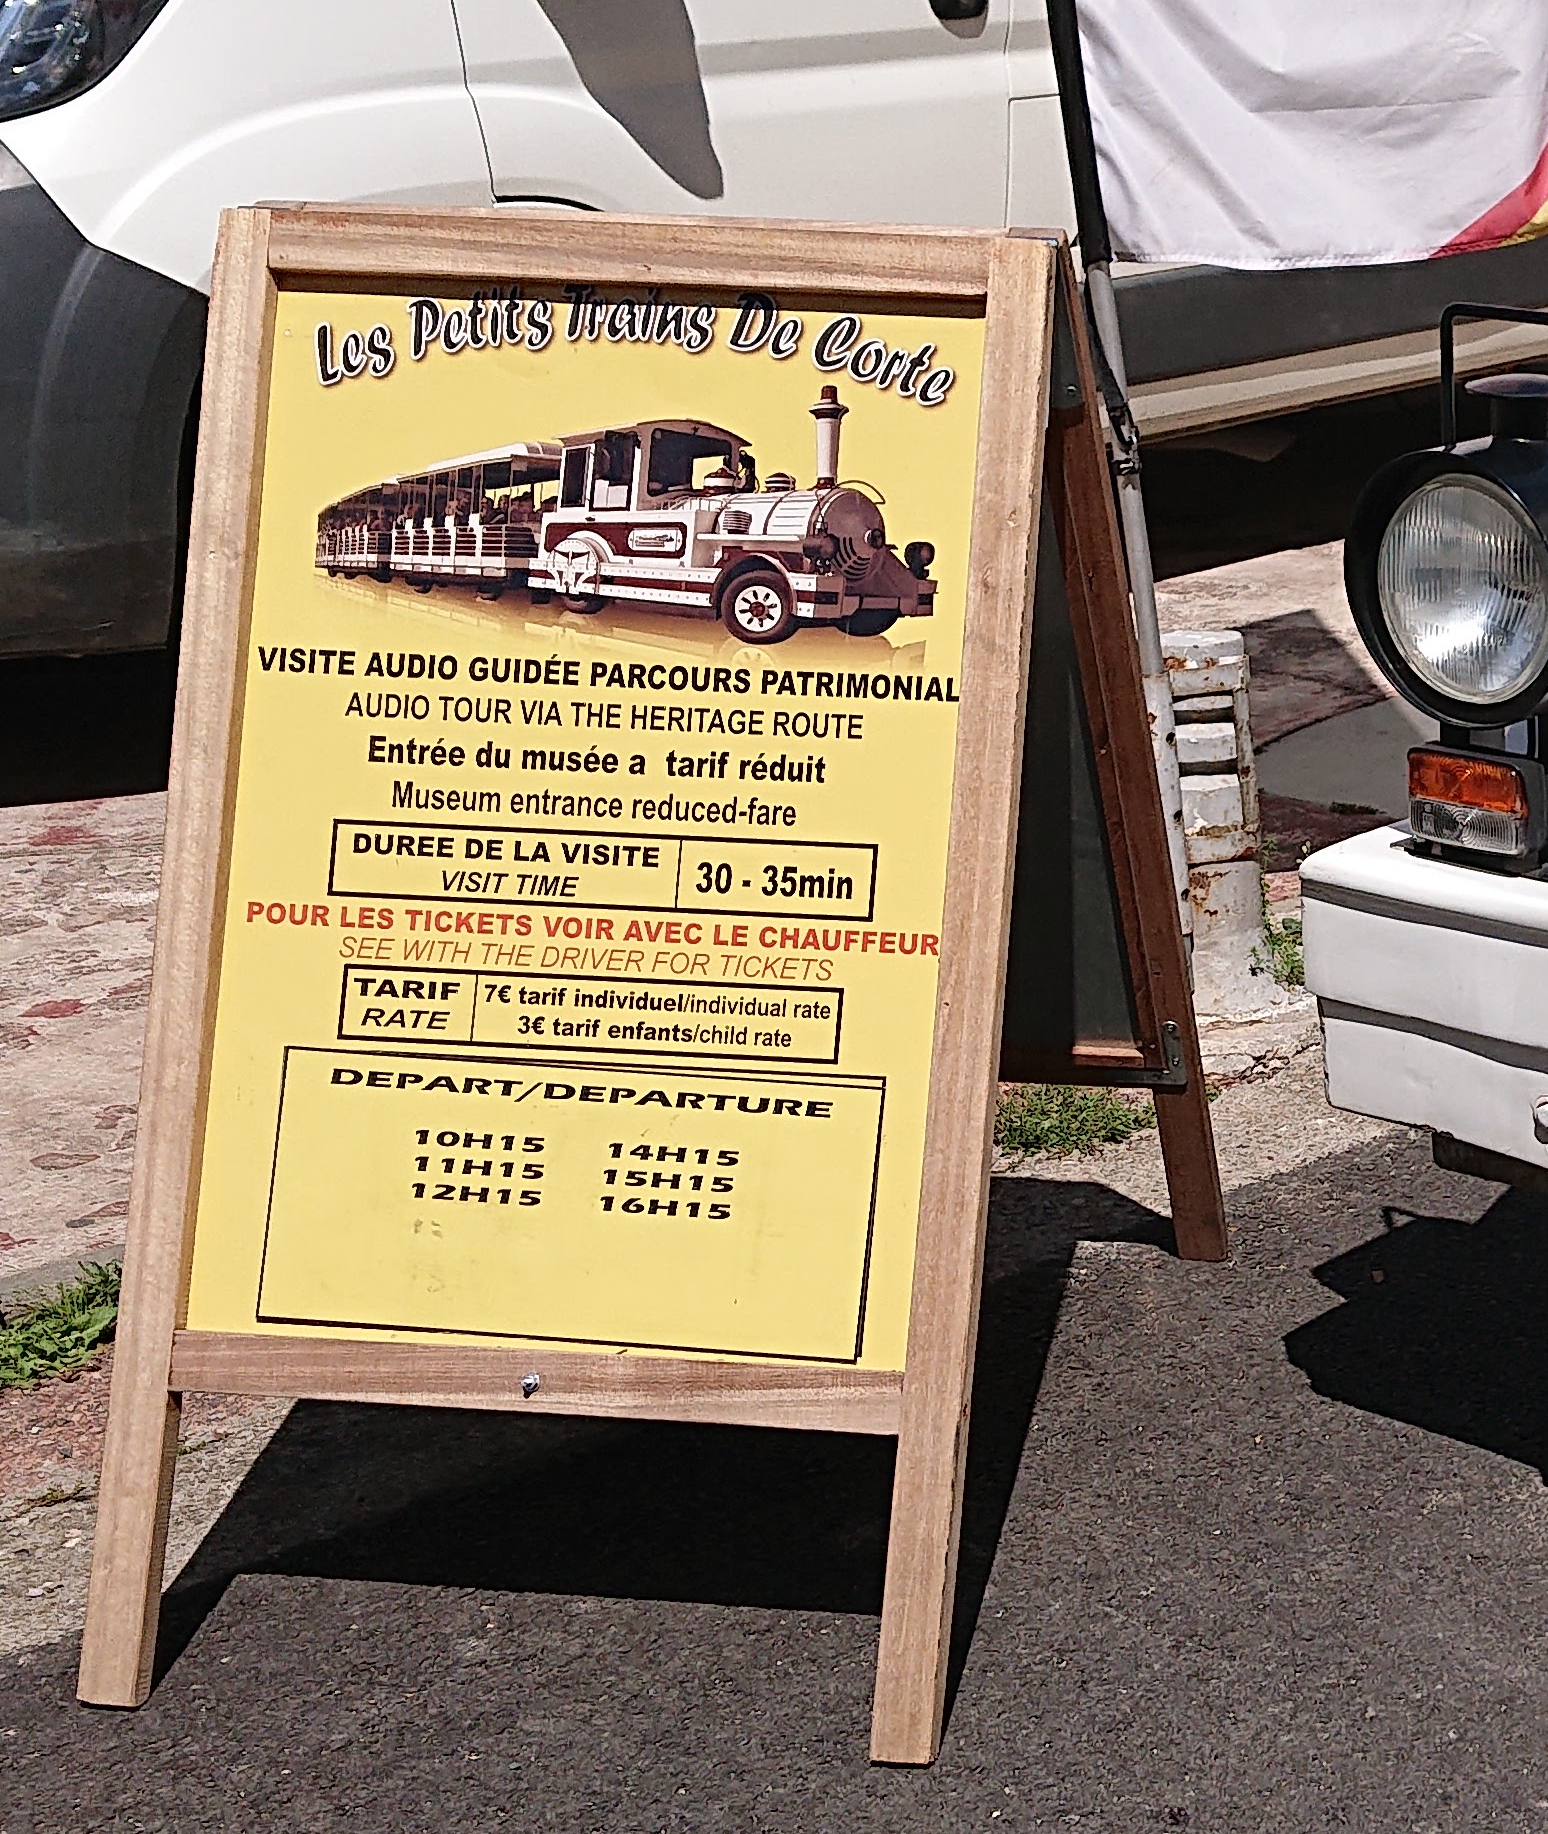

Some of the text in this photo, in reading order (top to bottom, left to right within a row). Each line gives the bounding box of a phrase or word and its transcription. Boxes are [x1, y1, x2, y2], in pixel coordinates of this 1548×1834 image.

[316, 284, 956, 405] Les Petits Trains De Corte
[258, 646, 960, 702] VISITE AUDIO GUIDÉE PARCOURS PATRIMONIAL
[345, 692, 864, 740] AUDIO TOUR VIA THE HERITAGE ROUTE
[368, 735, 826, 783] Entrée du musée a tarif réduit
[392, 780, 797, 826] Museum entrance reduced-fare
[353, 833, 660, 868] DUREE DE LA VISITE
[441, 870, 580, 897] VISIT TIME
[695, 862, 732, 894] 30
[761, 864, 853, 900] 35min
[246, 901, 940, 956] POUR LES TICKETS VOIR AVEC LE CHAUFFEUR
[339, 936, 834, 981] SEE WITH THE DRIVER FOR TICKETS
[353, 977, 461, 1001] TARIF
[484, 984, 831, 1019] 7€ tarif individuel/individual rate
[360, 1007, 451, 1031] RATE
[517, 1015, 792, 1048] 3€ tarif enfants/child rate
[330, 1068, 835, 1119] DEPART/DEPARTURE
[413, 1129, 740, 1166] 10H15 14H15
[413, 1155, 735, 1193] 11H15 15H15
[410, 1183, 732, 1220] 12H15 16H15
